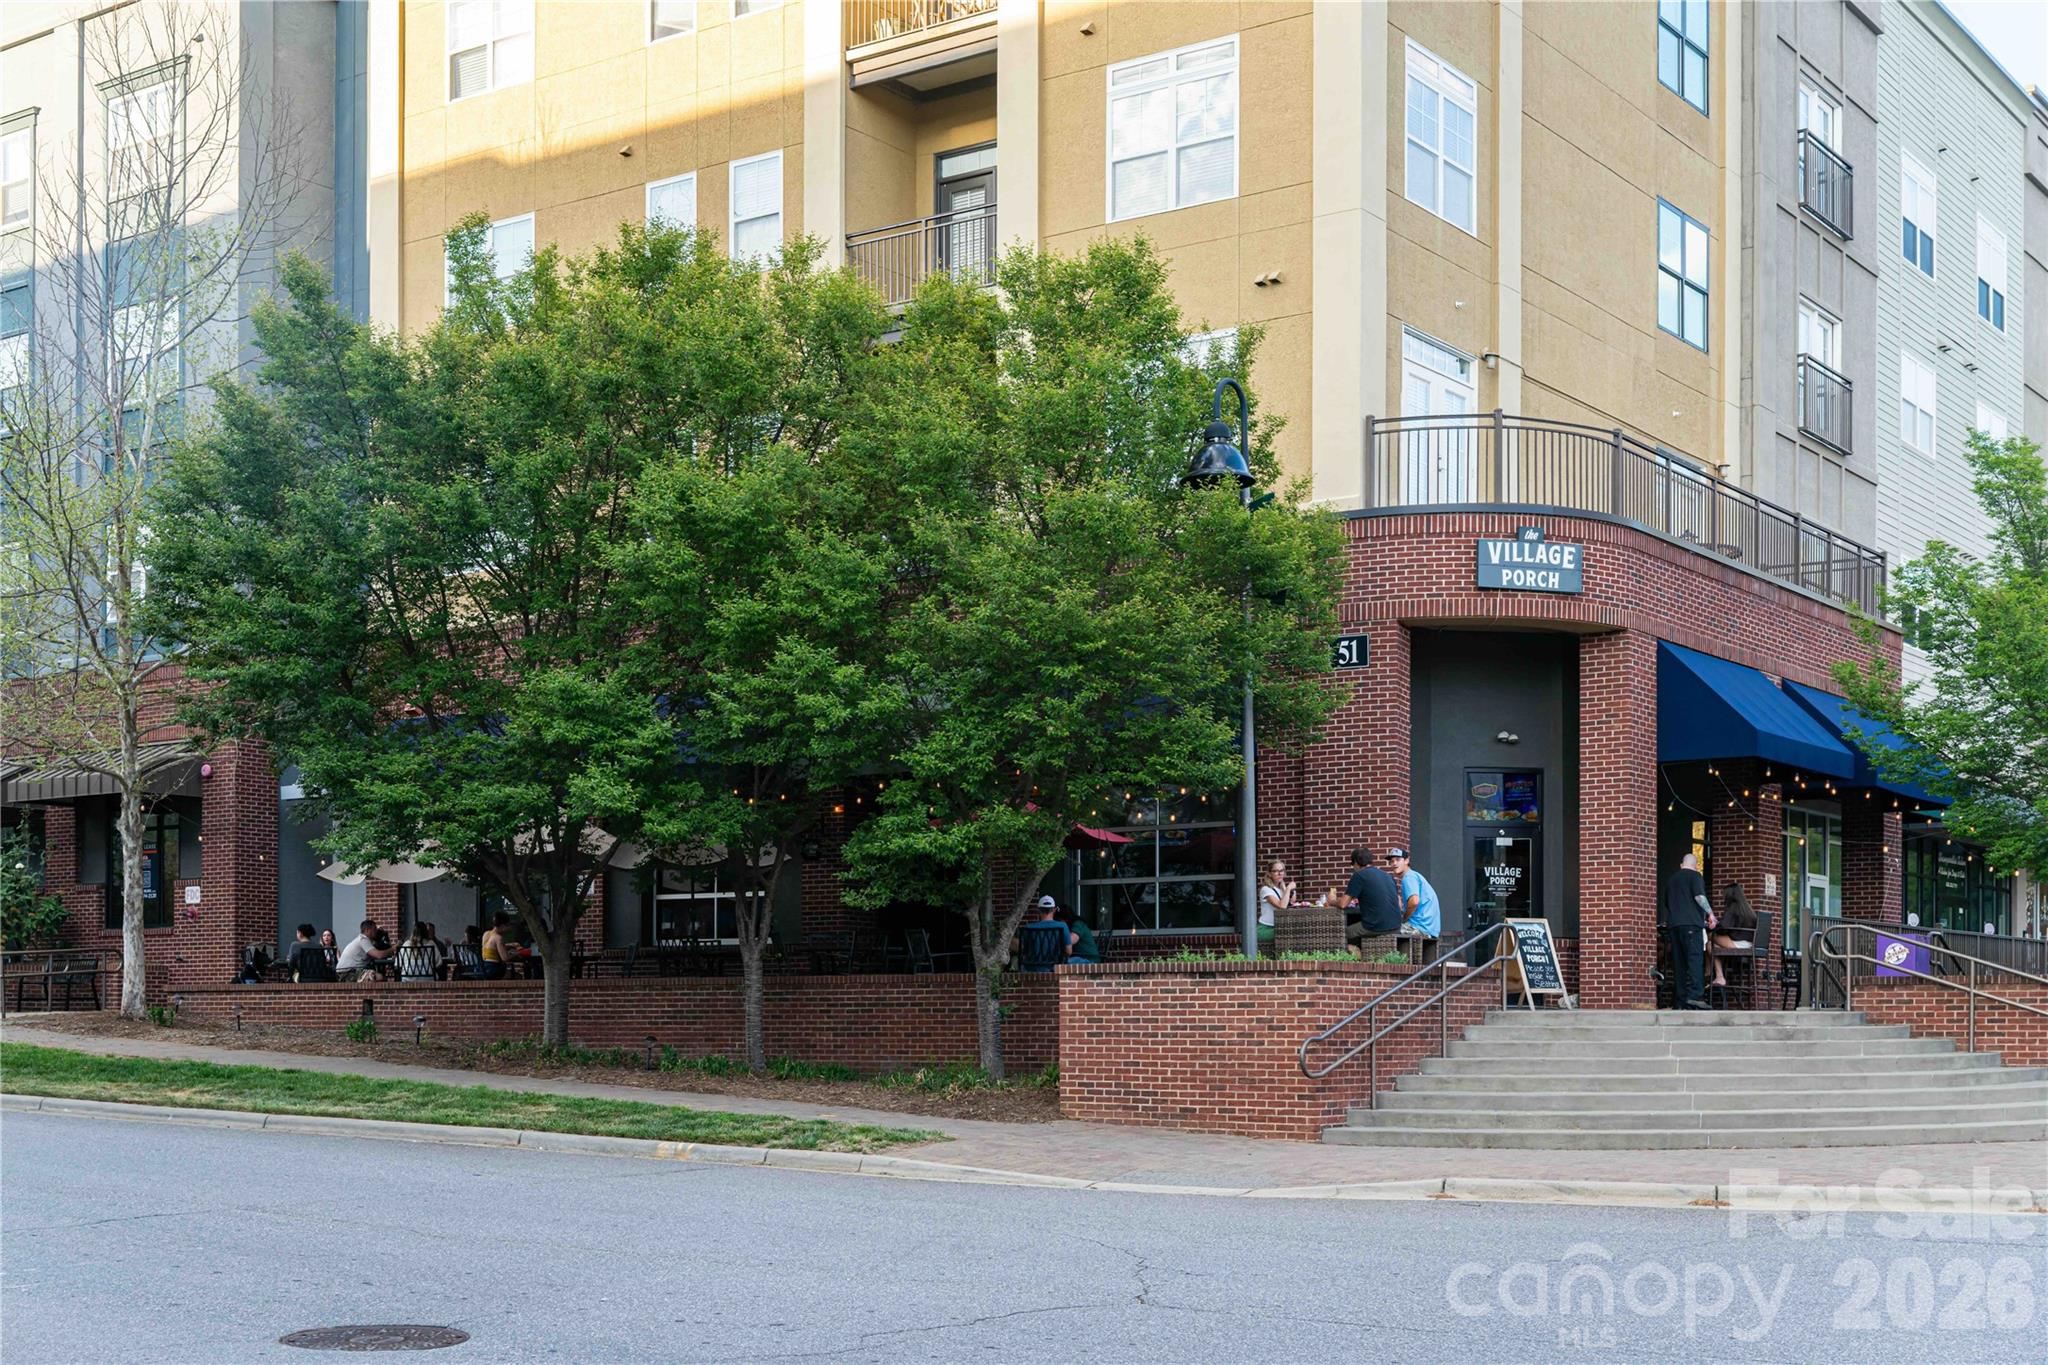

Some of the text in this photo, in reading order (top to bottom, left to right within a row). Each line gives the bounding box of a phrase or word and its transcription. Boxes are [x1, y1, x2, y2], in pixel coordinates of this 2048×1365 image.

[1524, 528, 1539, 540] the
[1487, 541, 1576, 569] VILLAGE
[1501, 569, 1560, 589] PORCH
[1484, 866, 1522, 878] VILLAGE
[1490, 876, 1516, 885] PORCH
[186, 889, 200, 900] FDC
[1522, 945, 1546, 954] VILLAGE
